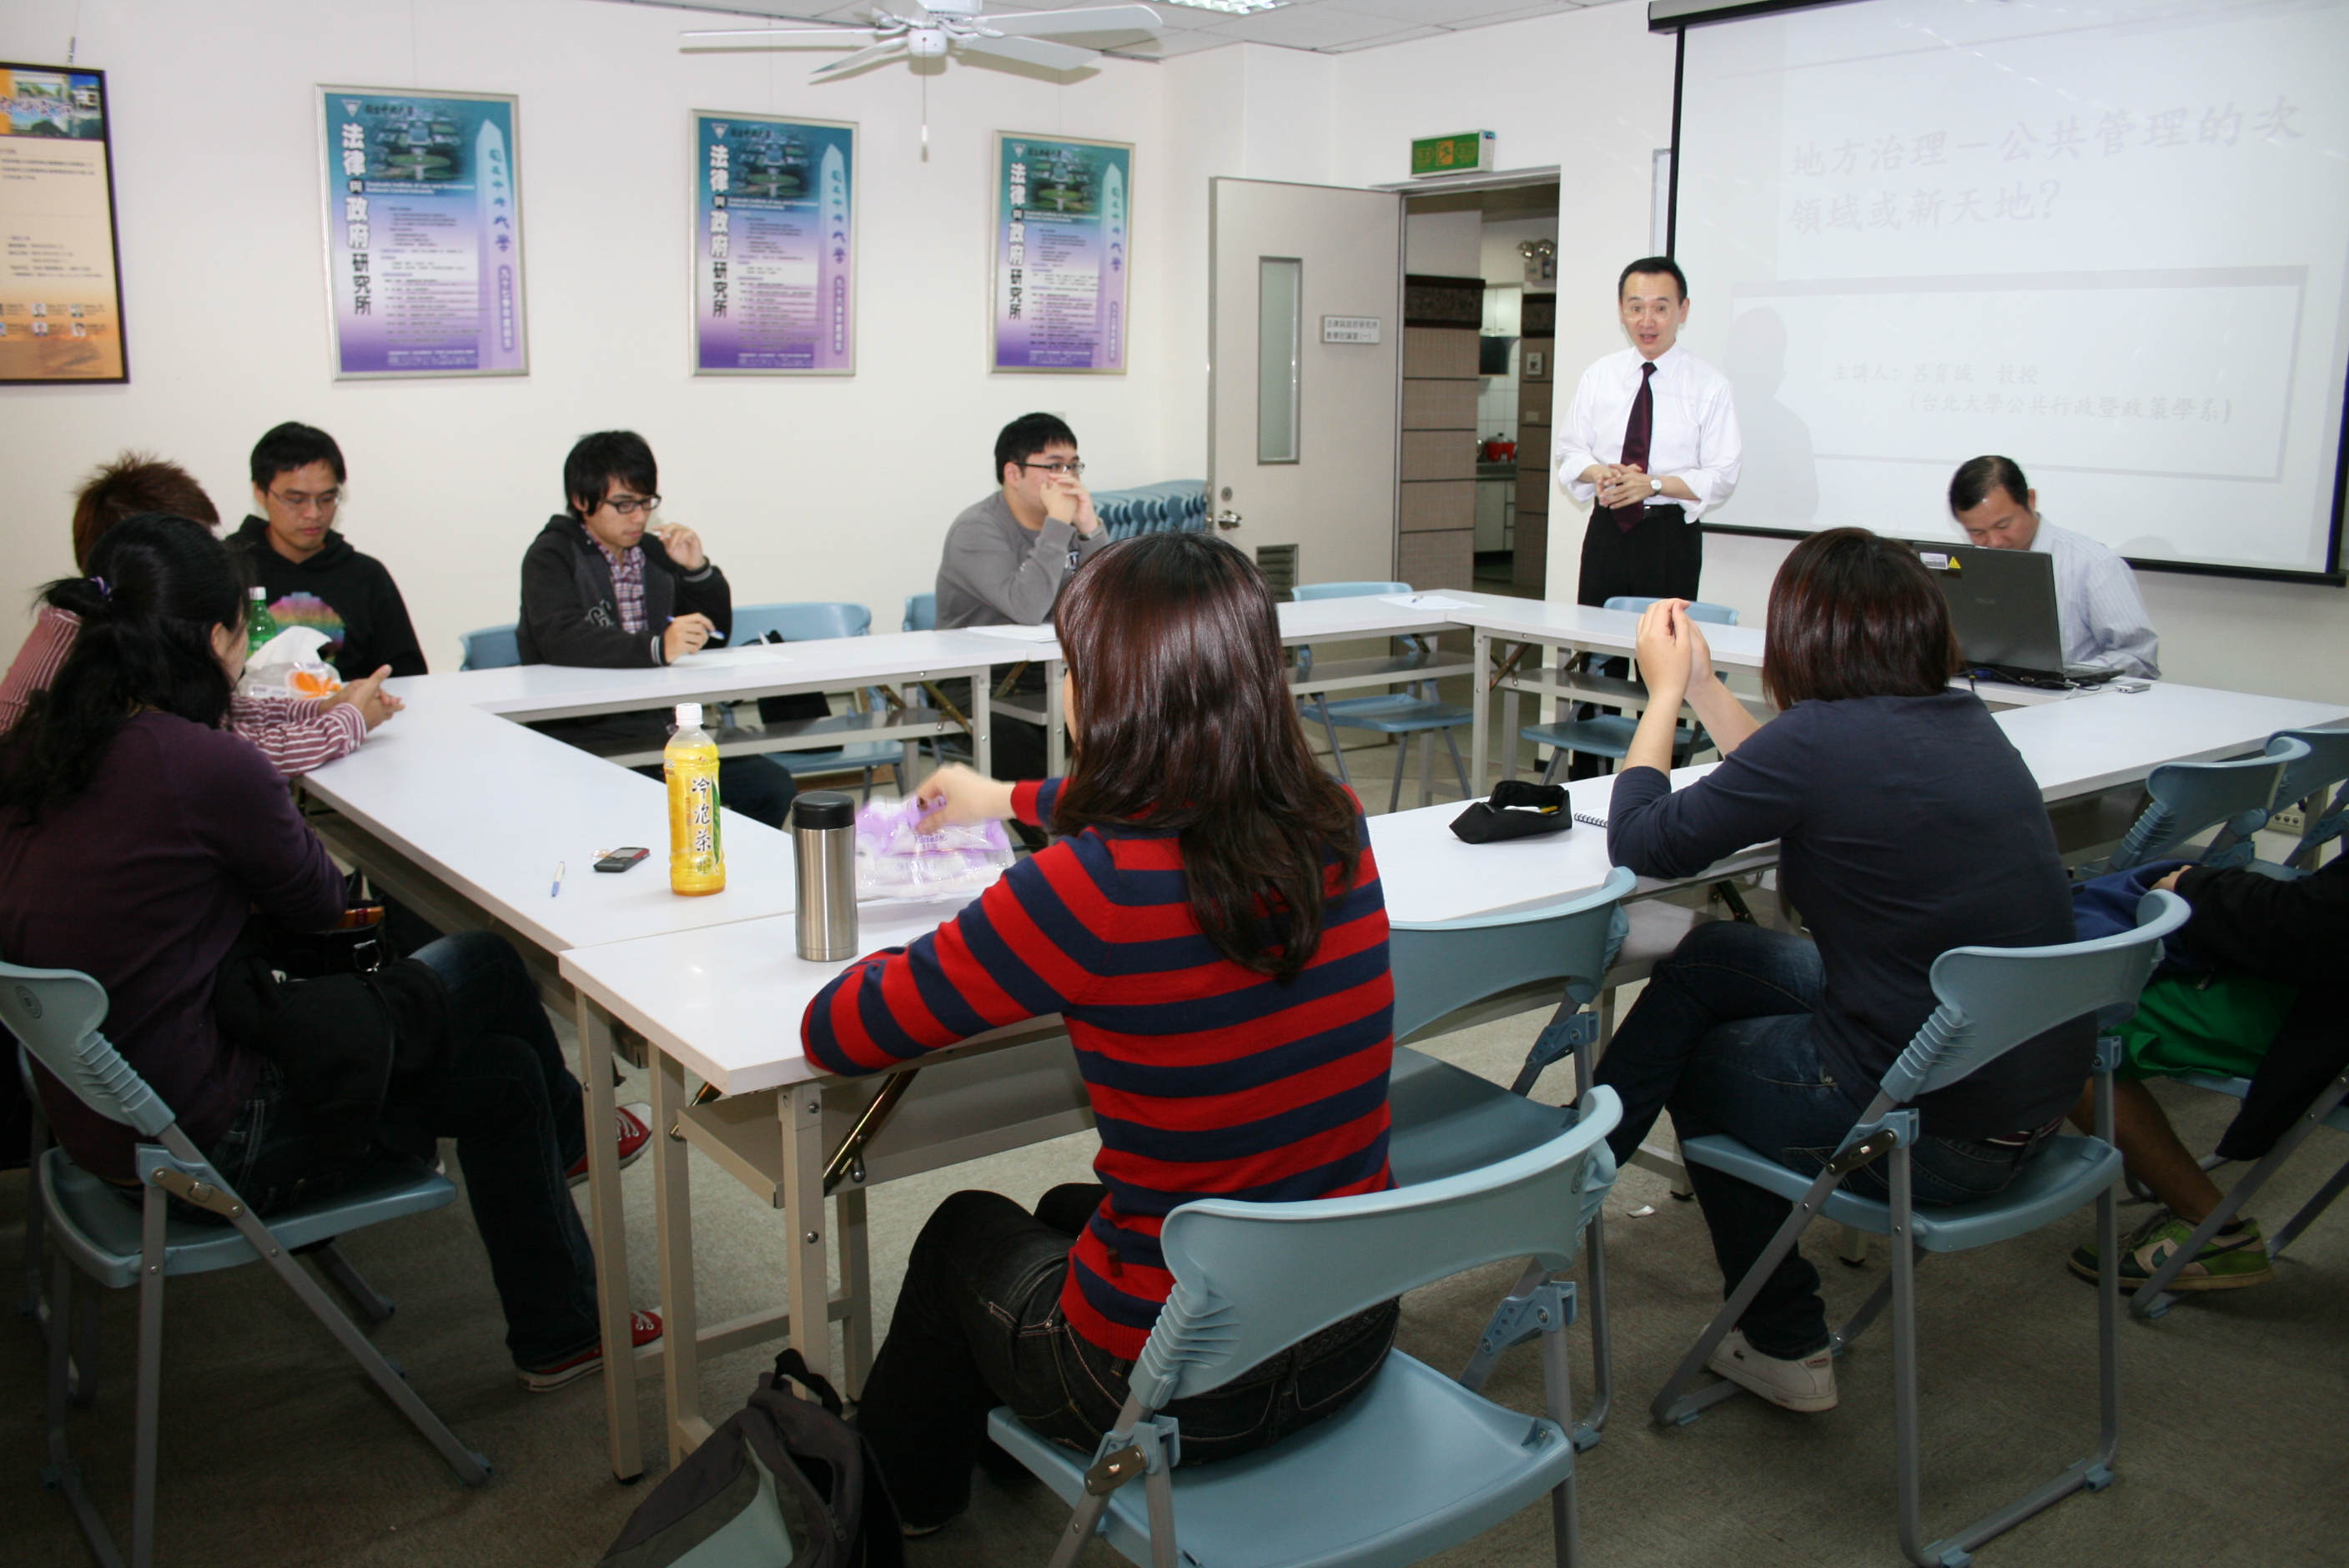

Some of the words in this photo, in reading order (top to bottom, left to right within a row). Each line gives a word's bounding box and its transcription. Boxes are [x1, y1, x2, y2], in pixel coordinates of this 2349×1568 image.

[1787, 179, 2061, 235] 領域或新天地?
[1914, 364, 1974, 384] 呂育誠
[1996, 364, 2040, 384] 教授
[692, 777, 712, 852] 冷泡茶
